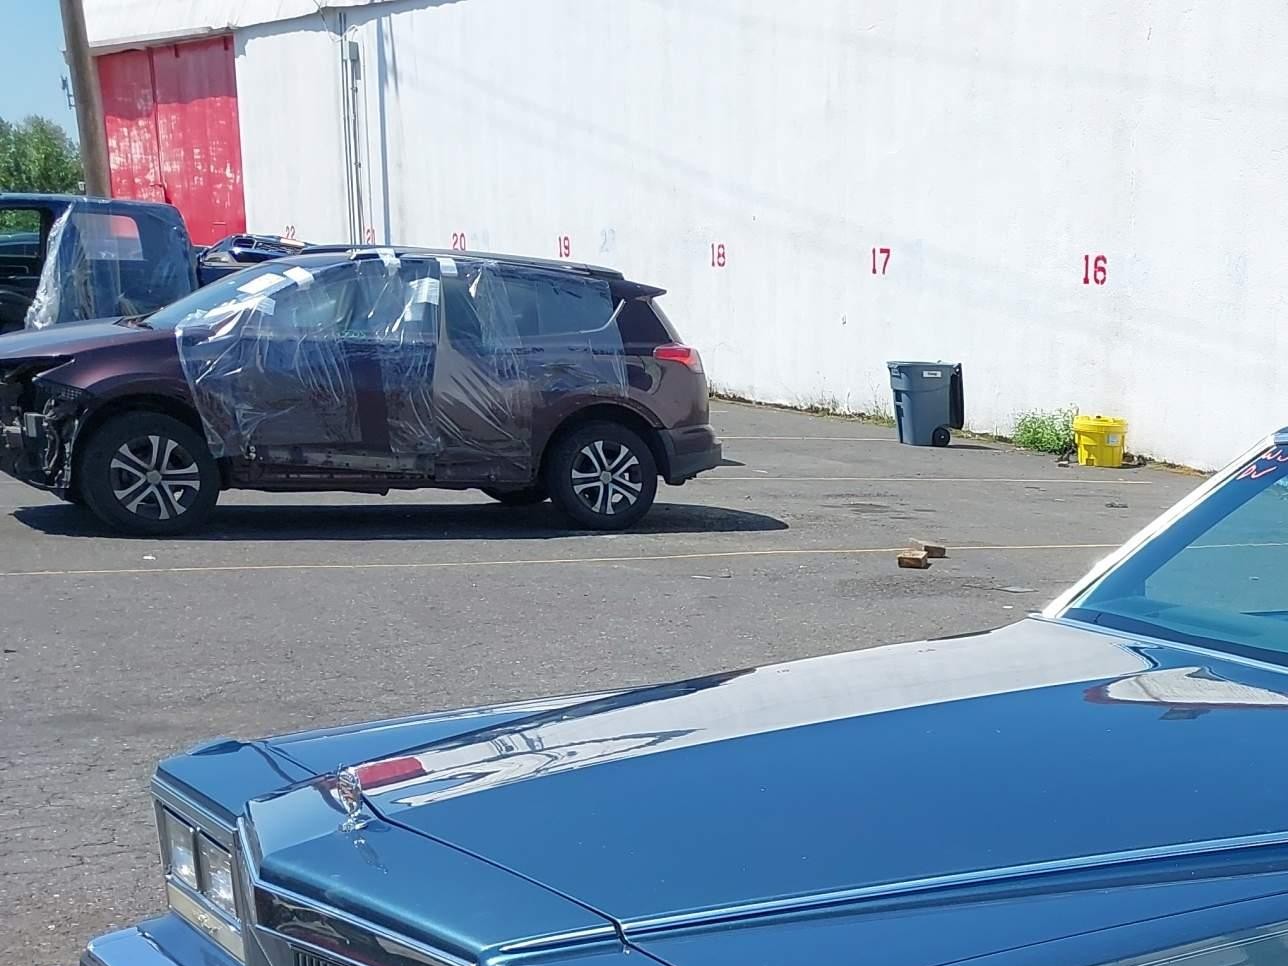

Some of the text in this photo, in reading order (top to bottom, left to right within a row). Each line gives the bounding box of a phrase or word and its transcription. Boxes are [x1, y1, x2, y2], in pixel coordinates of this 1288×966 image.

[452, 232, 466, 251] 20
[558, 235, 571, 258] 19
[711, 243, 727, 268] 18
[872, 247, 891, 275] 17
[1082, 254, 1108, 286] 16
